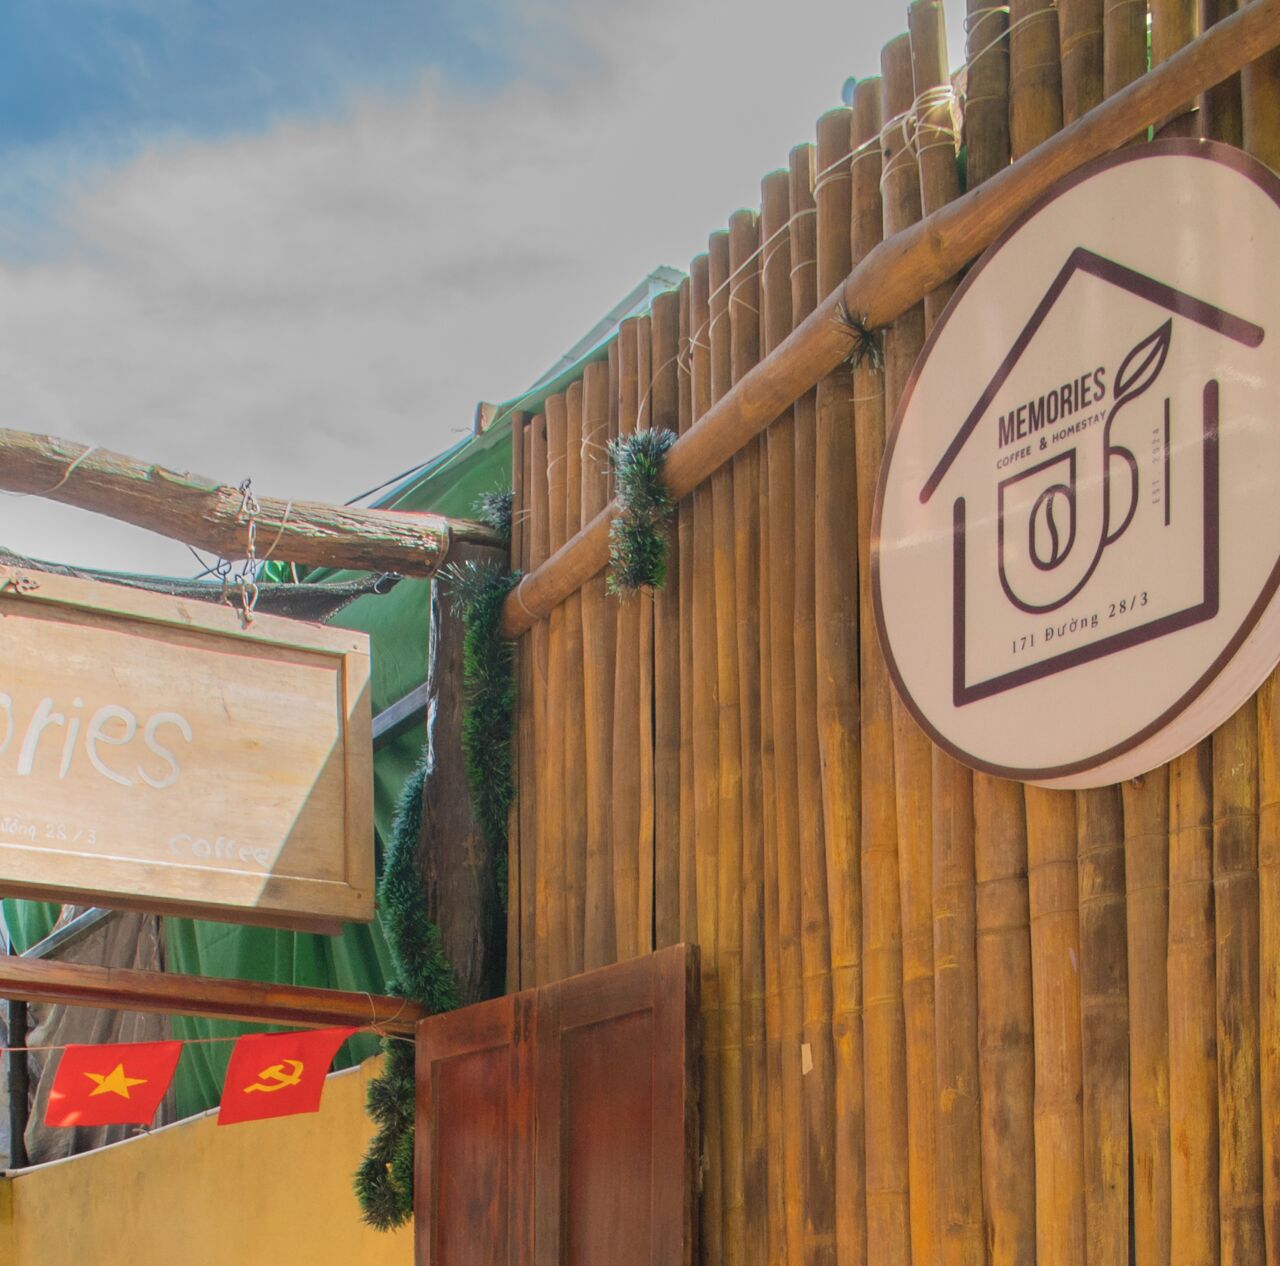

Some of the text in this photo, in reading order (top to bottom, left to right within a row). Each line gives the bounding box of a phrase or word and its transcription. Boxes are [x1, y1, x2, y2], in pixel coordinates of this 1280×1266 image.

[999, 366, 1106, 449] MEMORIES
[996, 410, 1107, 470] COFFEE & HOMESTAY
[1012, 634, 1034, 653] 171
[1045, 613, 1099, 642] Đường
[169, 833, 272, 866] Coffee
